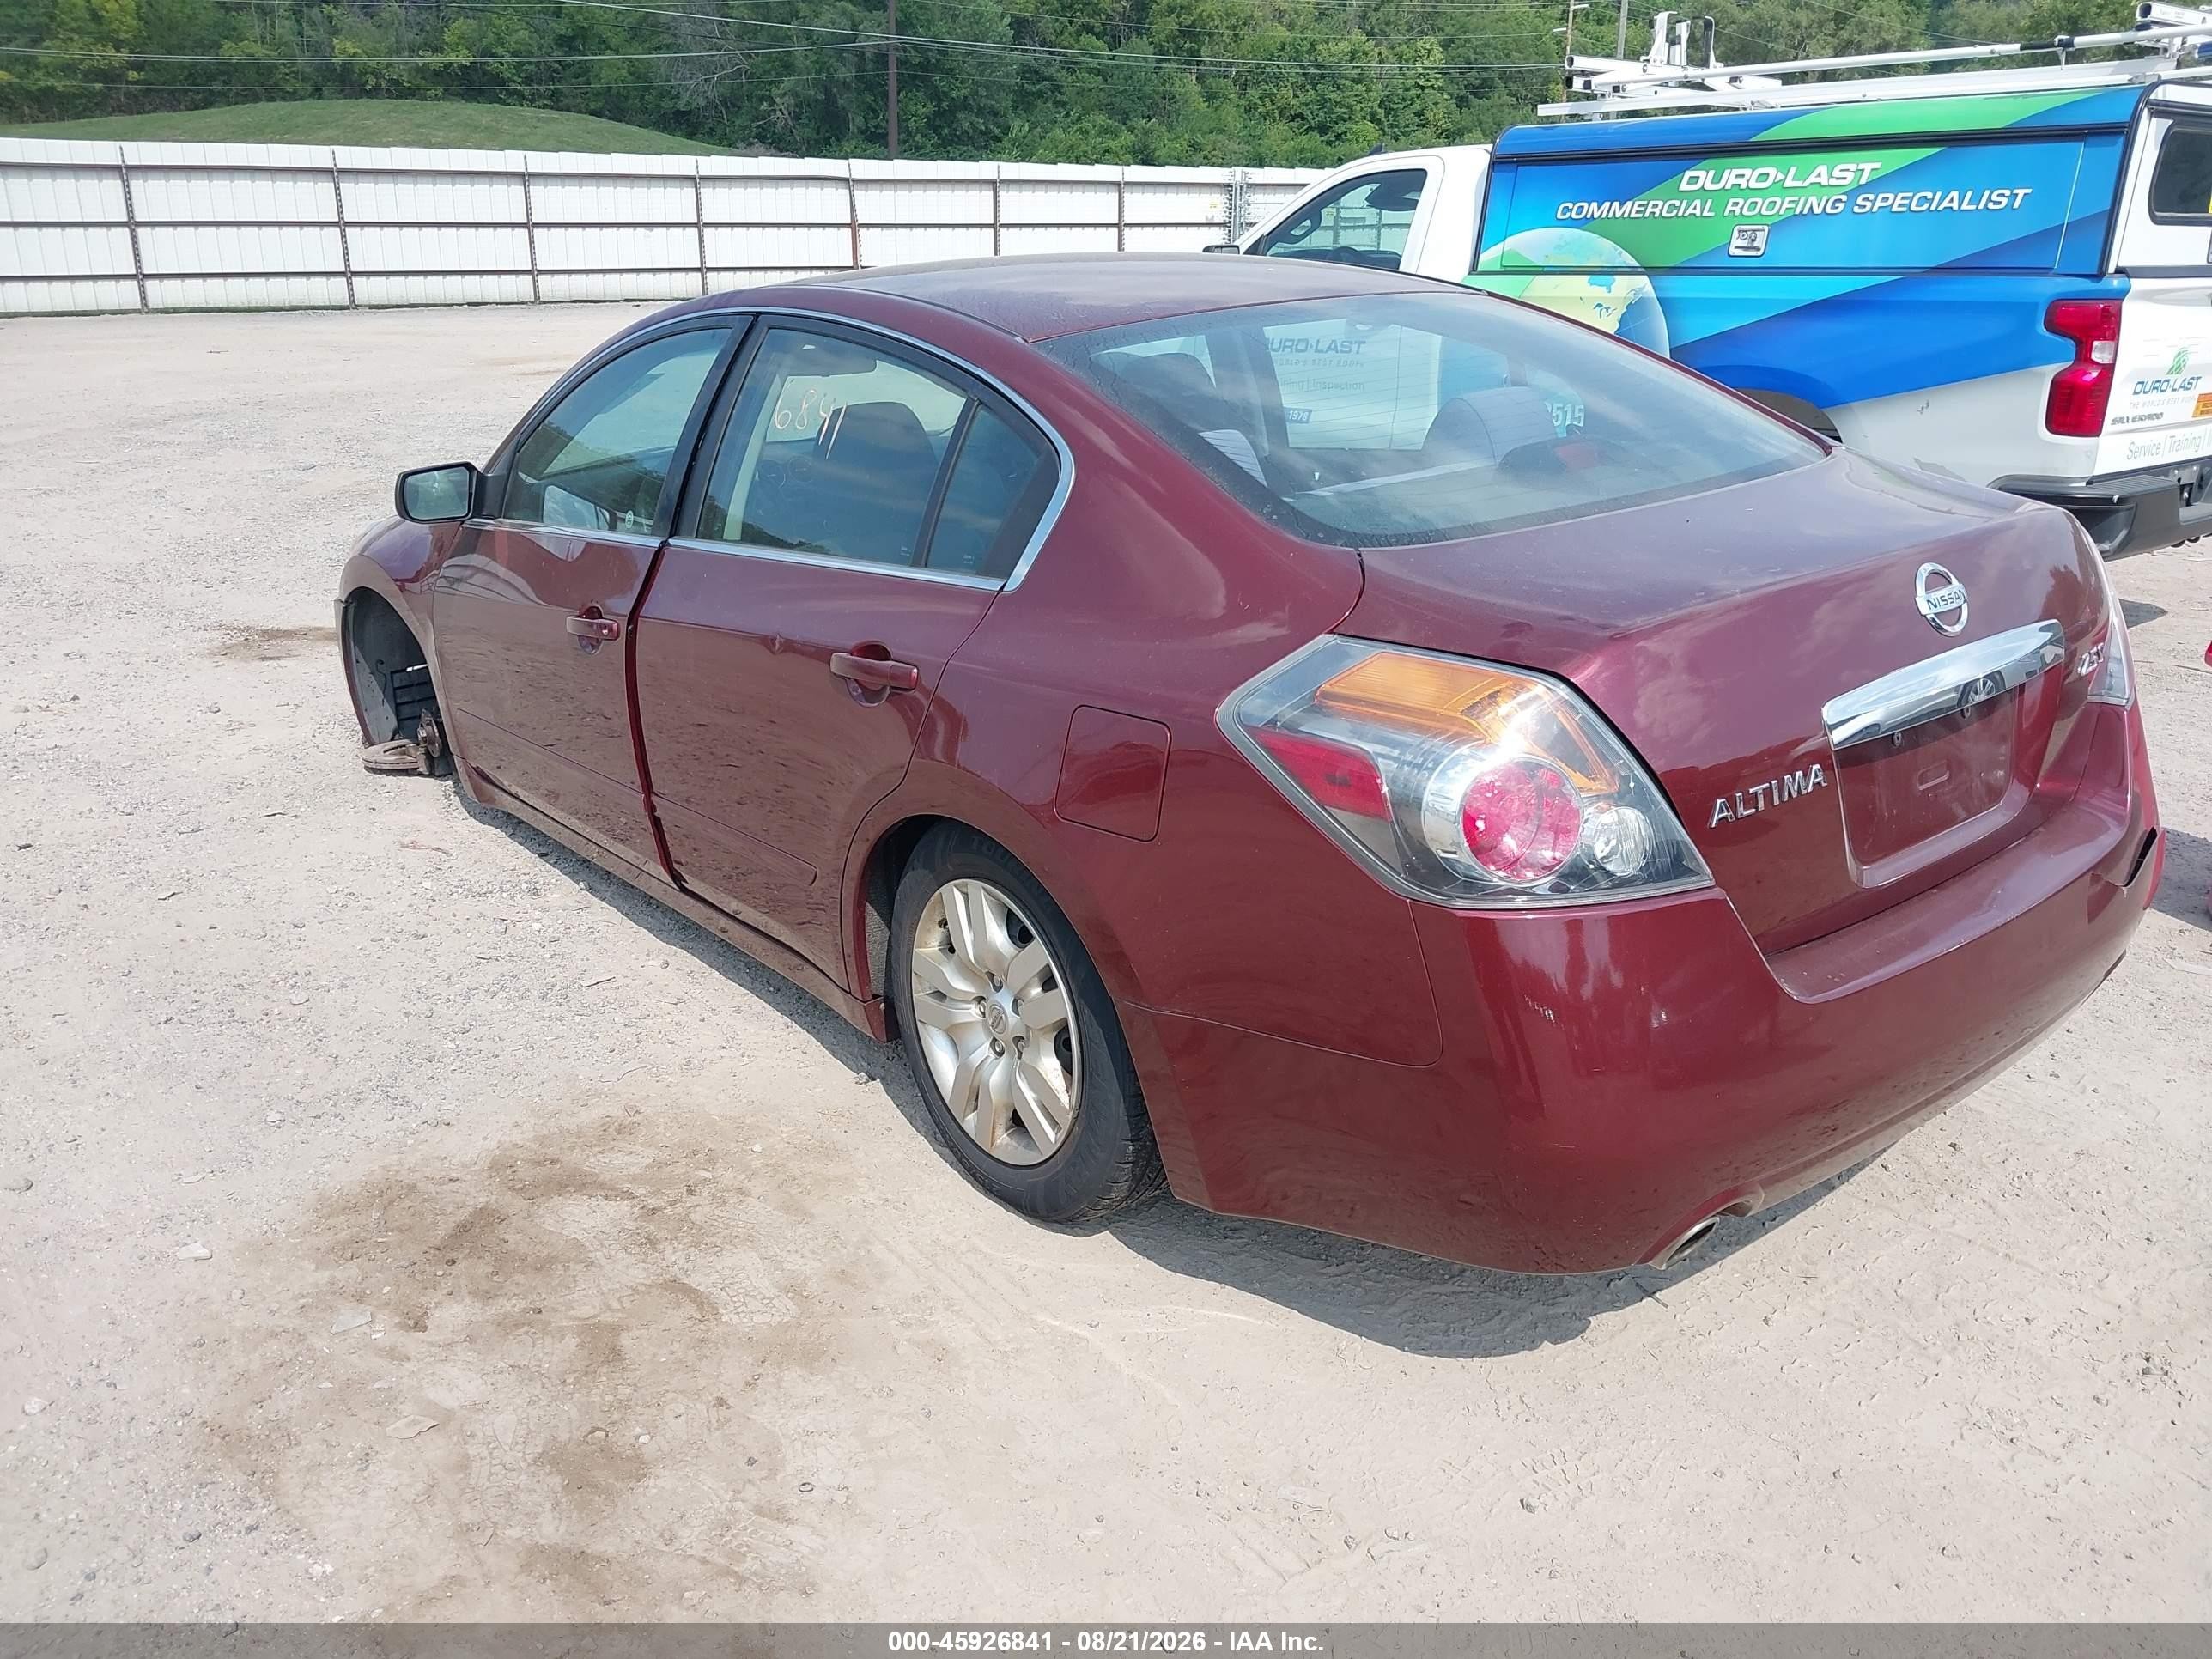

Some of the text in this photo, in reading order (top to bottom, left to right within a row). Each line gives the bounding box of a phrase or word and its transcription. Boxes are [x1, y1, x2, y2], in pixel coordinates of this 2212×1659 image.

[1555, 187, 2033, 220] COMMERCIAL ROOFING SPECIALIST
[2126, 441, 2162, 461] Service
[2167, 432, 2203, 453] Training
[1926, 588, 1967, 611] NISSAN
[1707, 763, 1828, 830] ALTIMA
